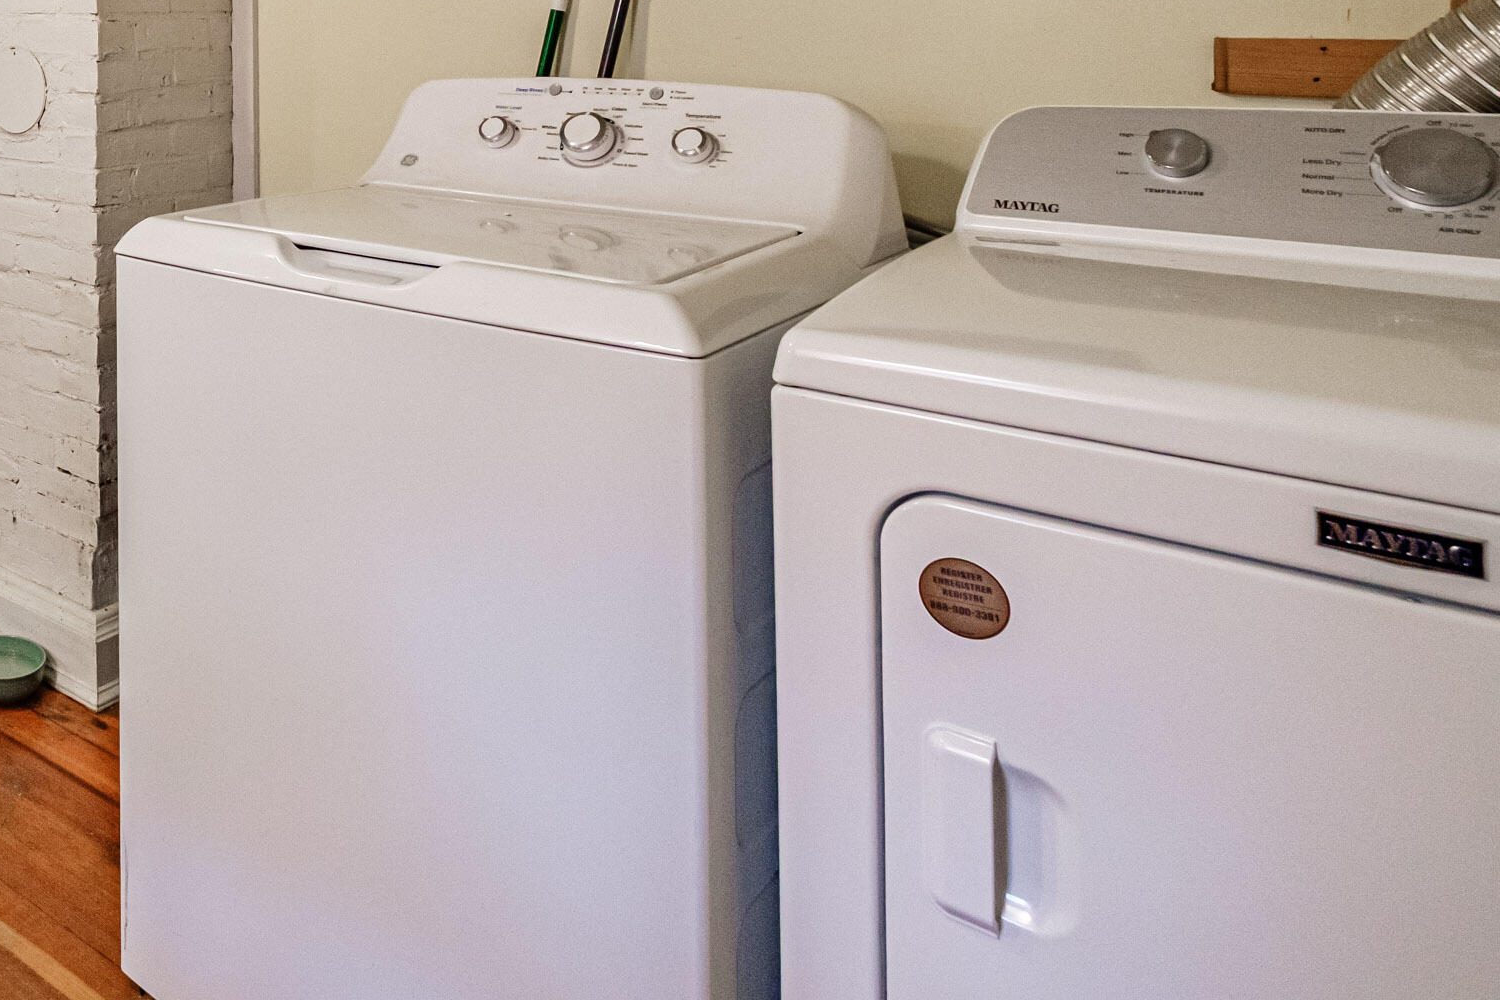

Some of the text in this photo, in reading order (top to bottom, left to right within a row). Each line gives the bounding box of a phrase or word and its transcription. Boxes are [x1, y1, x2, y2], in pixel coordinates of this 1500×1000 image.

[1302, 172, 1335, 181] Normal
[1143, 187, 1205, 197] TEMPERATURE
[1301, 188, 1328, 196] More
[993, 198, 1060, 214] MAYTAG
[1325, 519, 1474, 568] MAYTAG
[941, 567, 983, 582] REGISTER
